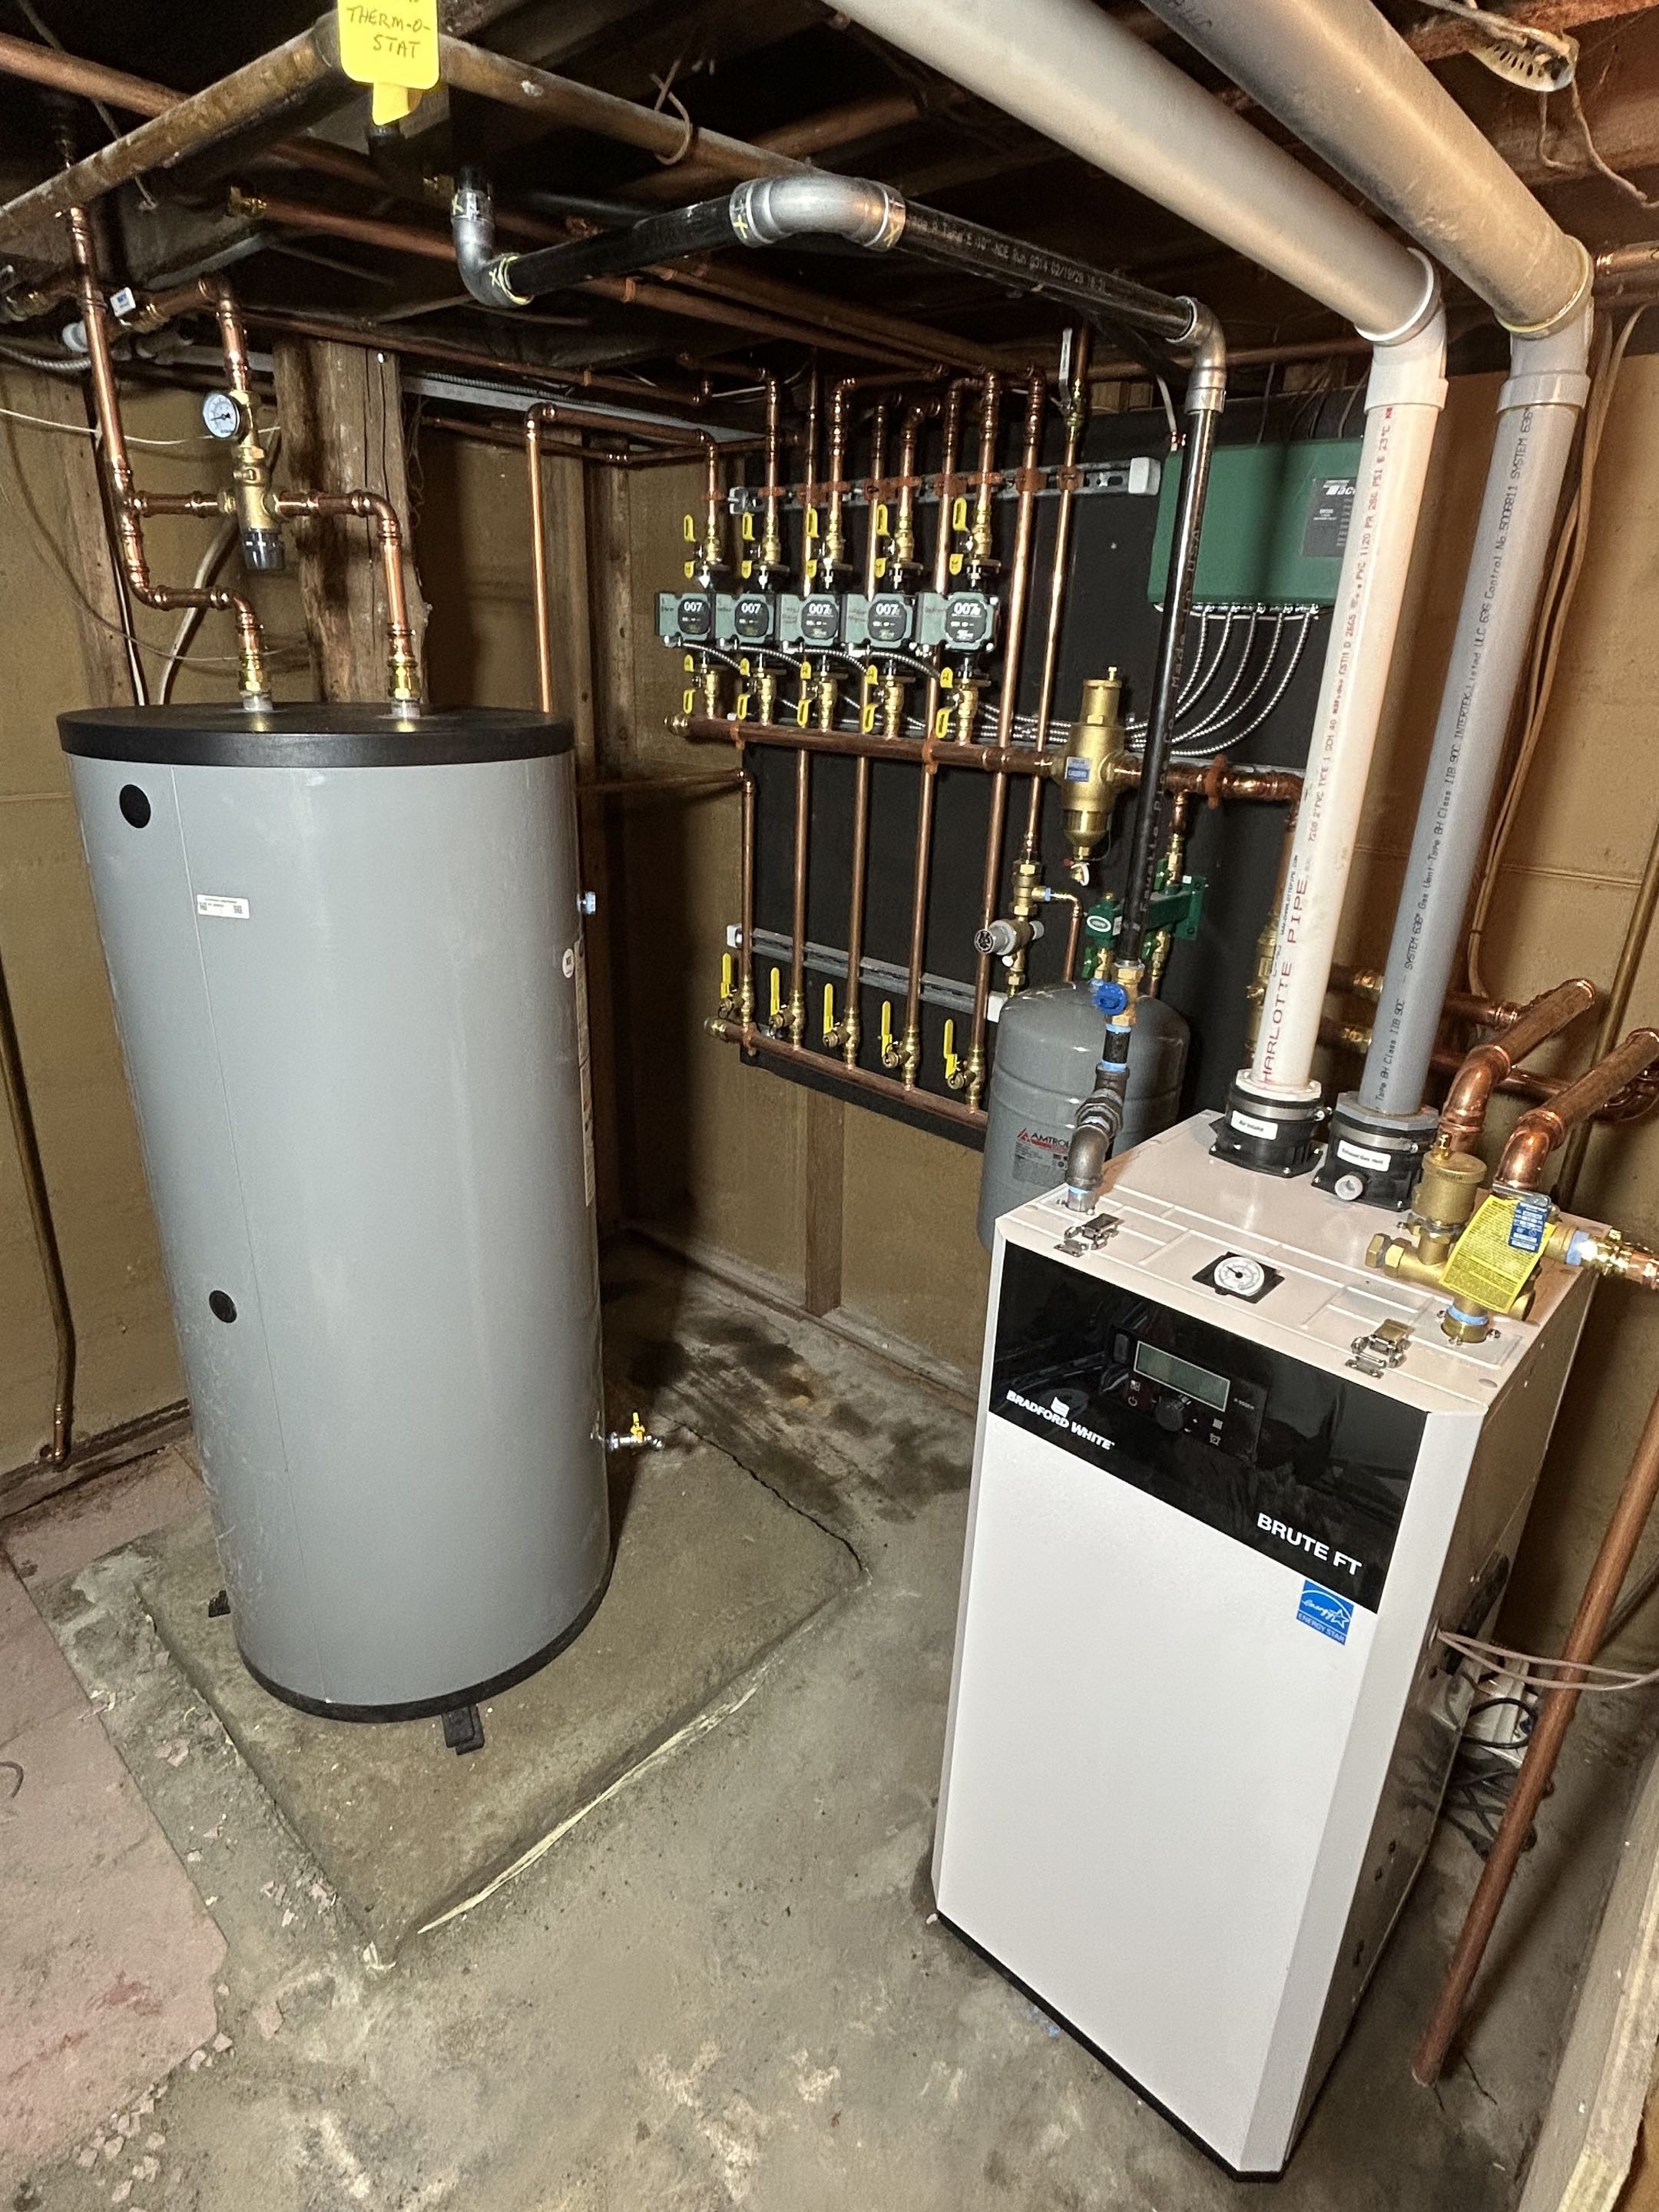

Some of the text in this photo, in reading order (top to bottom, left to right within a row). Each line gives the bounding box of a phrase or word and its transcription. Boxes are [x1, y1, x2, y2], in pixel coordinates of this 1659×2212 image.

[346, 5, 431, 33] THERM-O-
[373, 35, 421, 58] STAT
[1509, 436, 1528, 481] SYSTEM
[1323, 479, 1356, 496] Tac
[1186, 528, 1200, 571] USA
[1483, 554, 1502, 600] Control
[1479, 601, 1492, 624] 636
[1473, 627, 1488, 647] ULC
[1465, 651, 1482, 690] Listed
[1329, 717, 1338, 730] 40
[1453, 692, 1472, 740] INTERTEK
[1435, 789, 1452, 819] Class
[1426, 838, 1442, 862] Type
[1286, 878, 1308, 944] PIPE
[1417, 891, 1429, 910] Gas
[1403, 935, 1420, 971] SYSTEM
[1374, 1081, 1388, 1101] Type
[1382, 1038, 1397, 1065] Class
[1031, 1132, 1070, 1147] AMTROL
[1006, 1389, 1069, 1429] BRADFORD
[1257, 1512, 1363, 1575] BRUTE FT
[1297, 1613, 1346, 1643] ENERGY STAR
